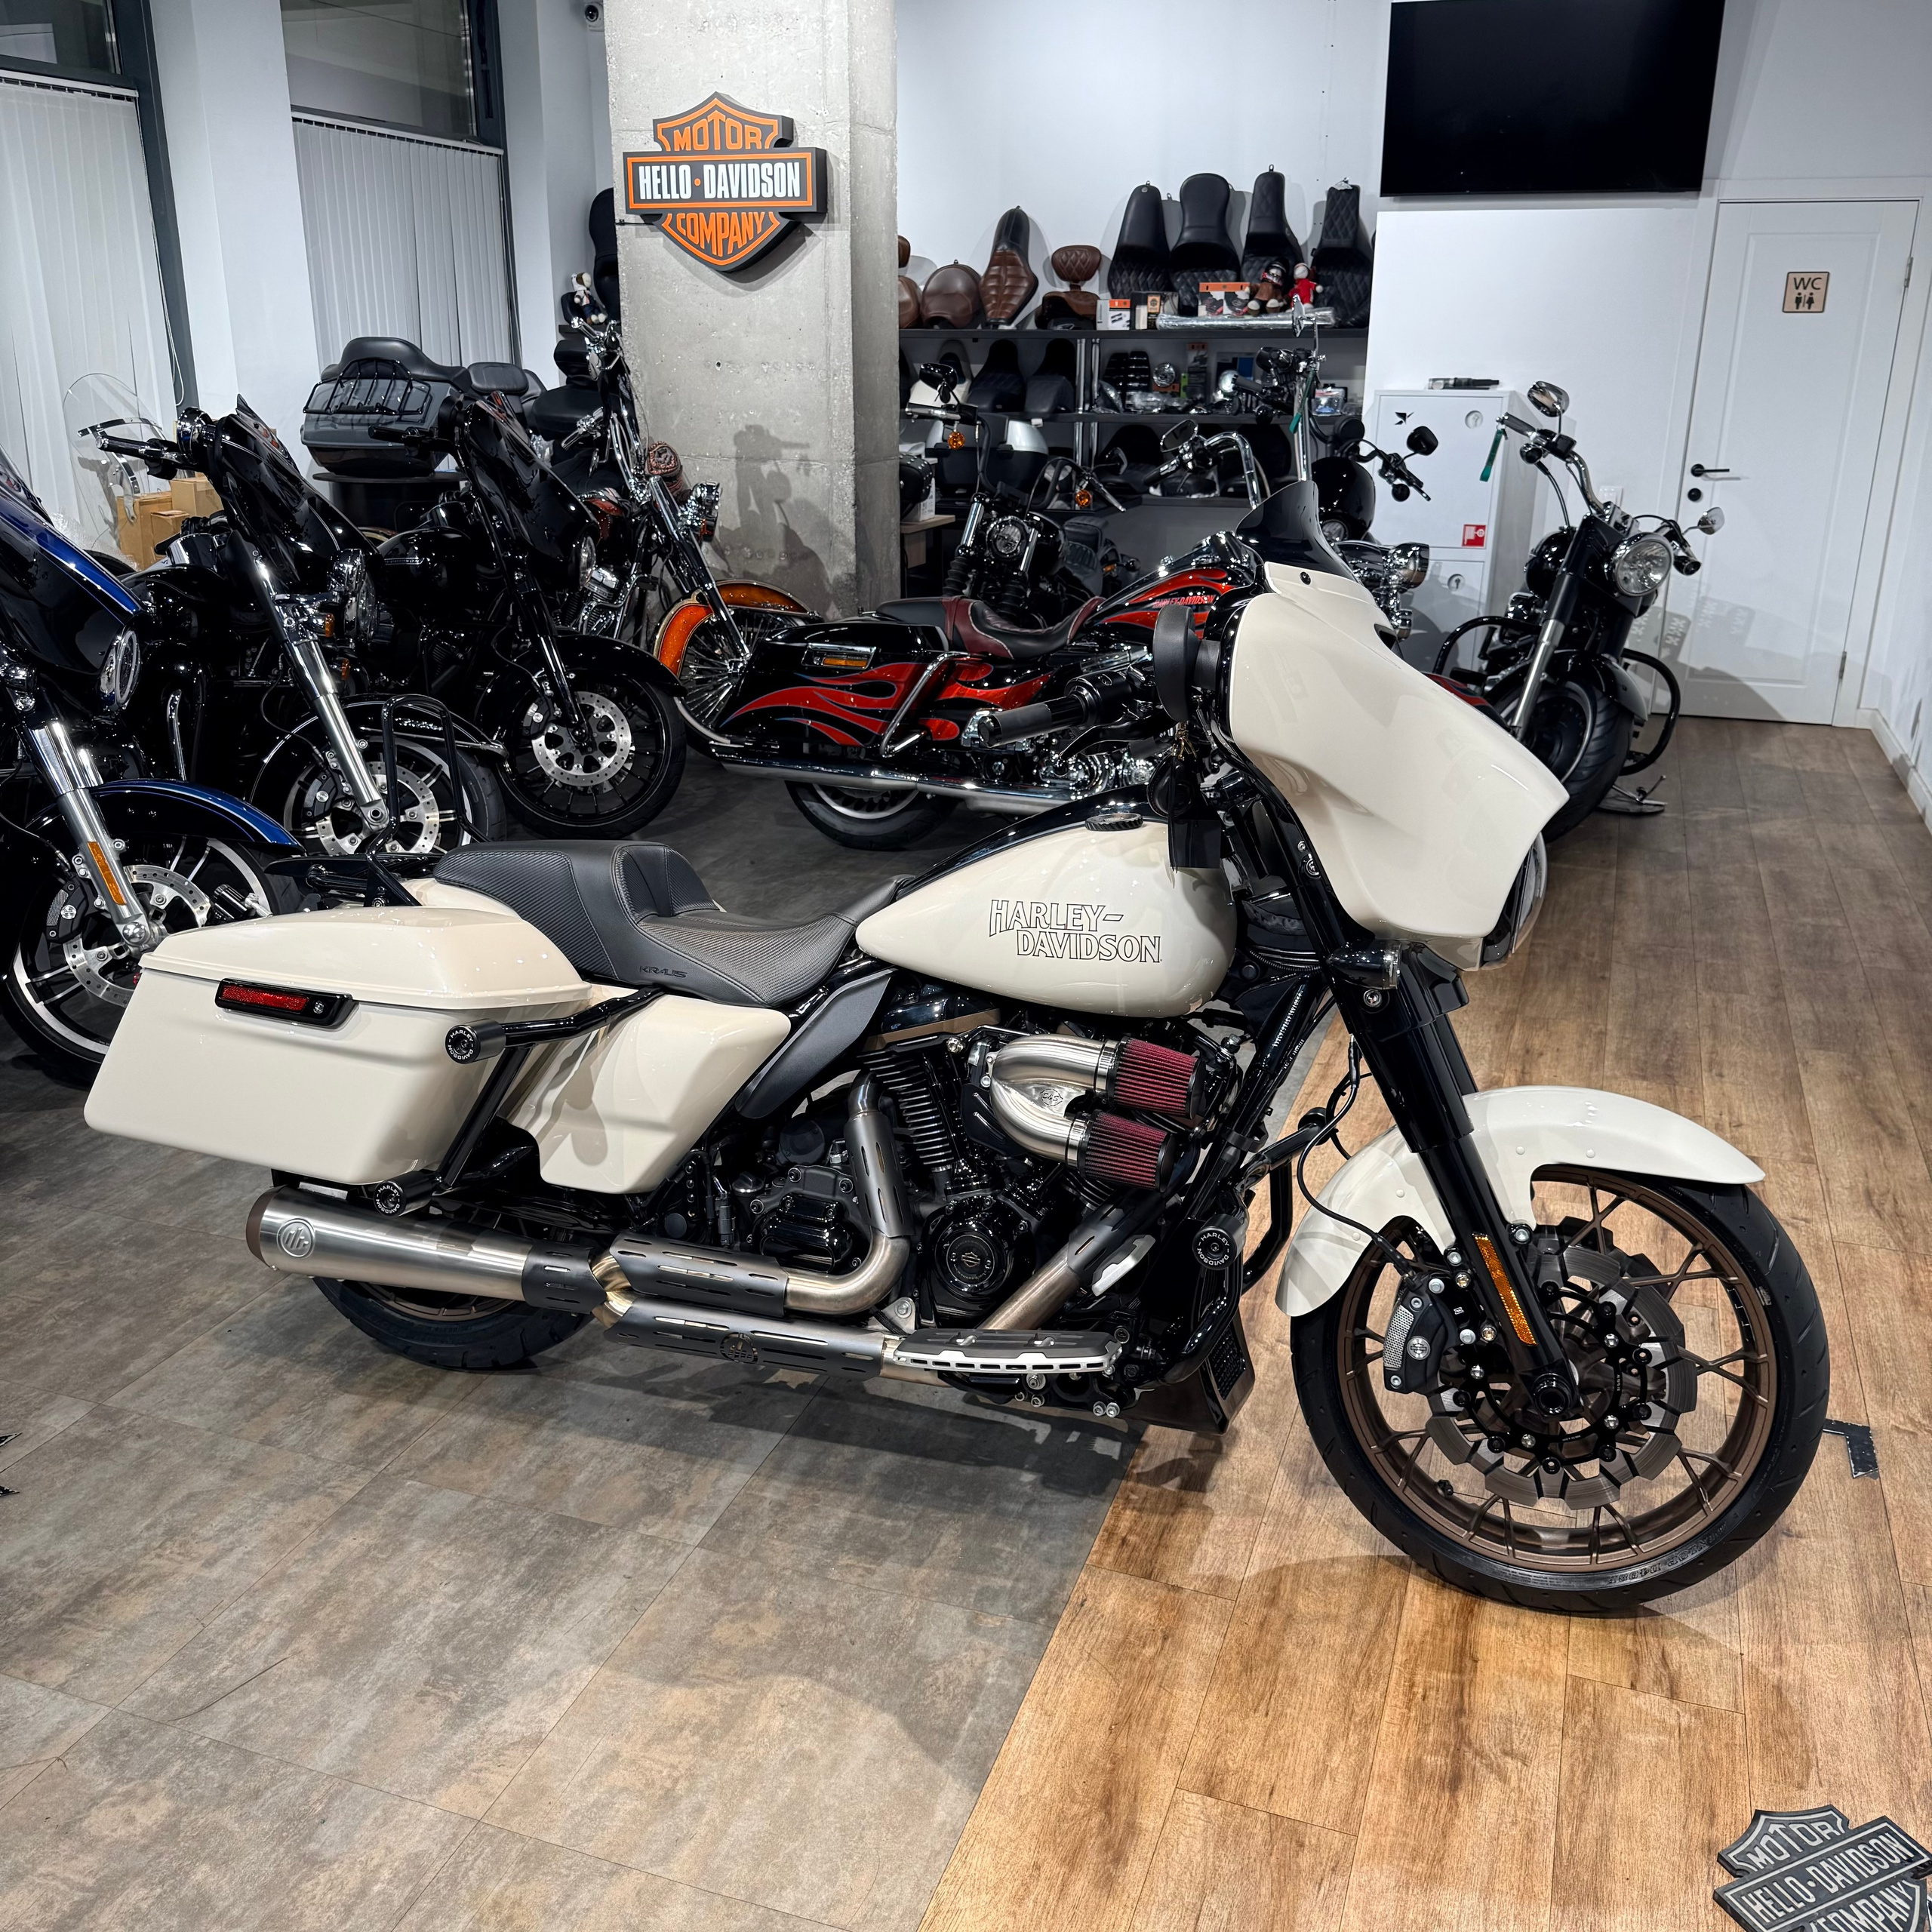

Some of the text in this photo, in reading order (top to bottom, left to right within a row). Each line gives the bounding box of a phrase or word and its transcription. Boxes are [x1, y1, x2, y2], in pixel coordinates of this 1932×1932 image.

[673, 109, 761, 152] MOTOR
[638, 162, 801, 200] HELLO DAVIDSON
[676, 211, 765, 257] COMPANY
[1793, 277, 1823, 291] WC
[1017, 930, 1161, 963] DAVIDSON
[639, 966, 688, 978] KRAUS
[1197, 1232, 1229, 1266] HARLEY DAVIDSON
[1747, 1821, 1840, 1869] MOTOR
[1742, 1832, 1915, 1923] HELLO DAVIDSON
